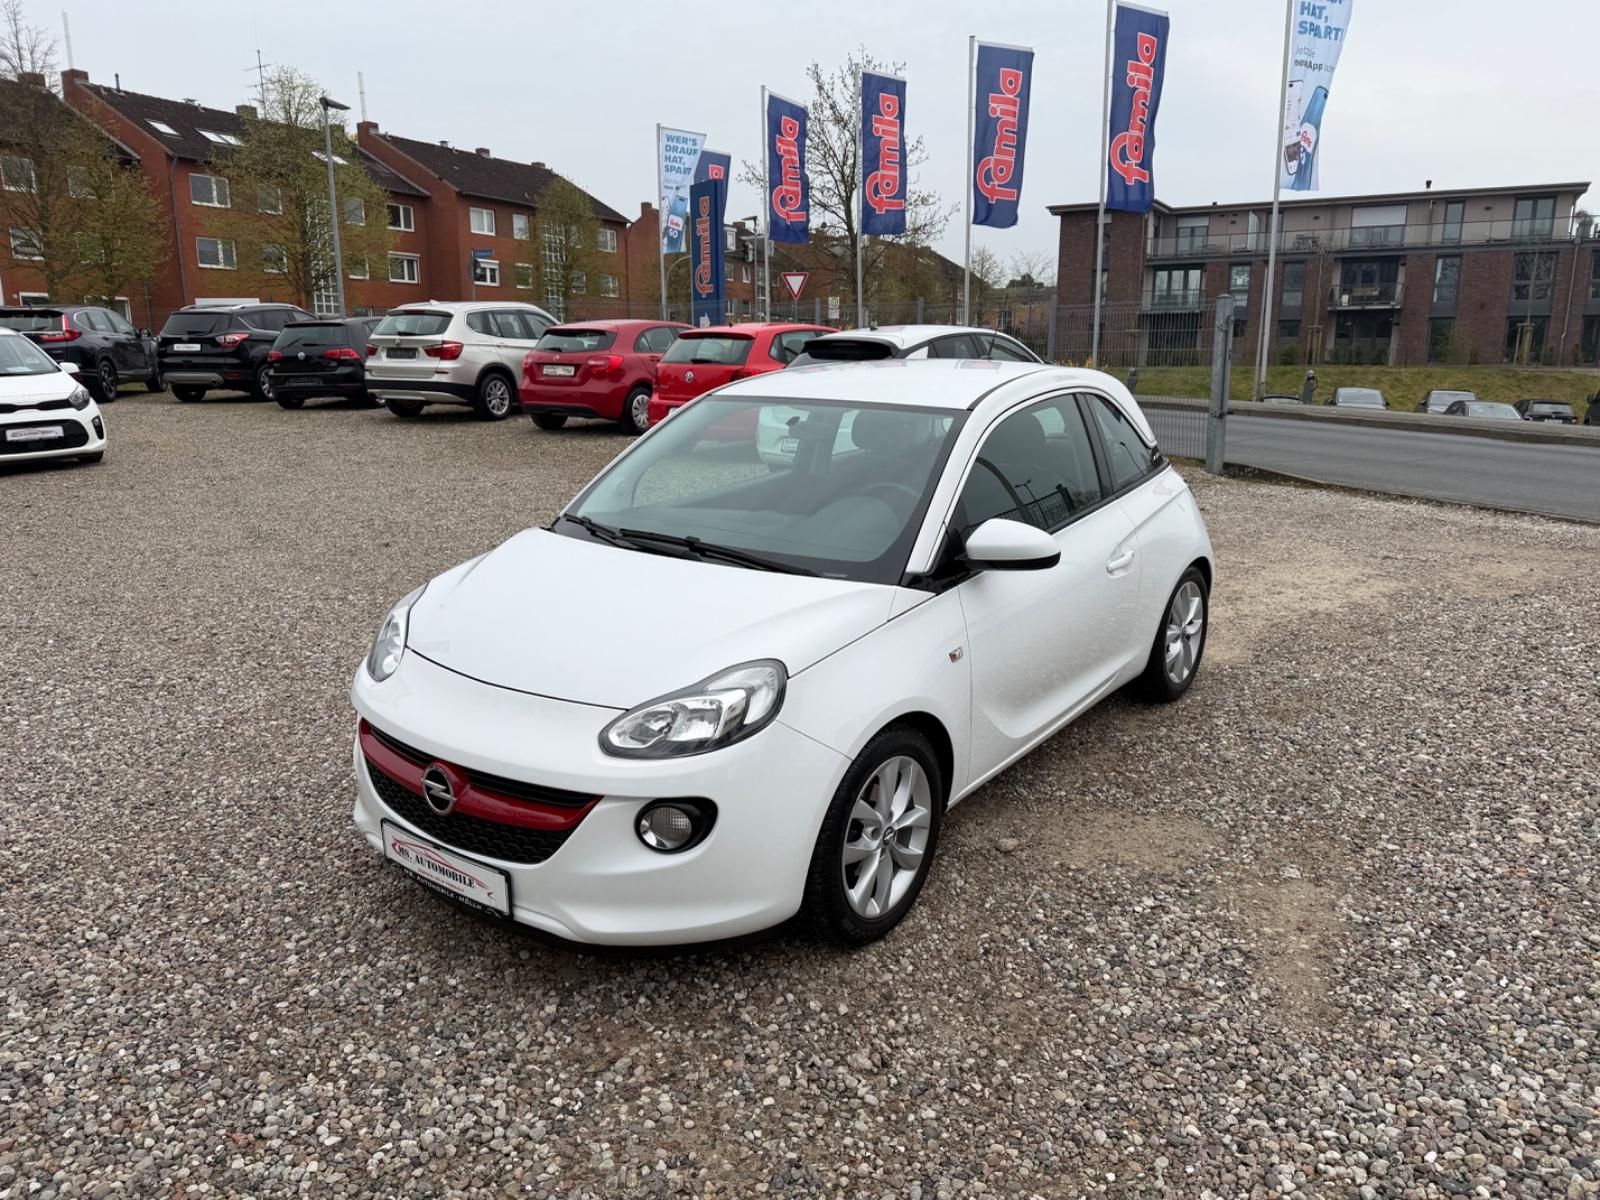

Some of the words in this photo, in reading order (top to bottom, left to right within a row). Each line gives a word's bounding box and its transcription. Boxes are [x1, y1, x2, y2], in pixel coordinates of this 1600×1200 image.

[1300, 1, 1329, 24] HAT,
[665, 134, 698, 147] WER'S
[977, 67, 1023, 204] famila
[1109, 31, 1157, 185] famila
[664, 155, 686, 166] HAT,
[665, 144, 699, 156] DRAUF
[772, 115, 806, 224] famila
[866, 92, 904, 214] famila
[695, 196, 714, 297] famila
[415, 854, 475, 889] AUTOMOBILE
